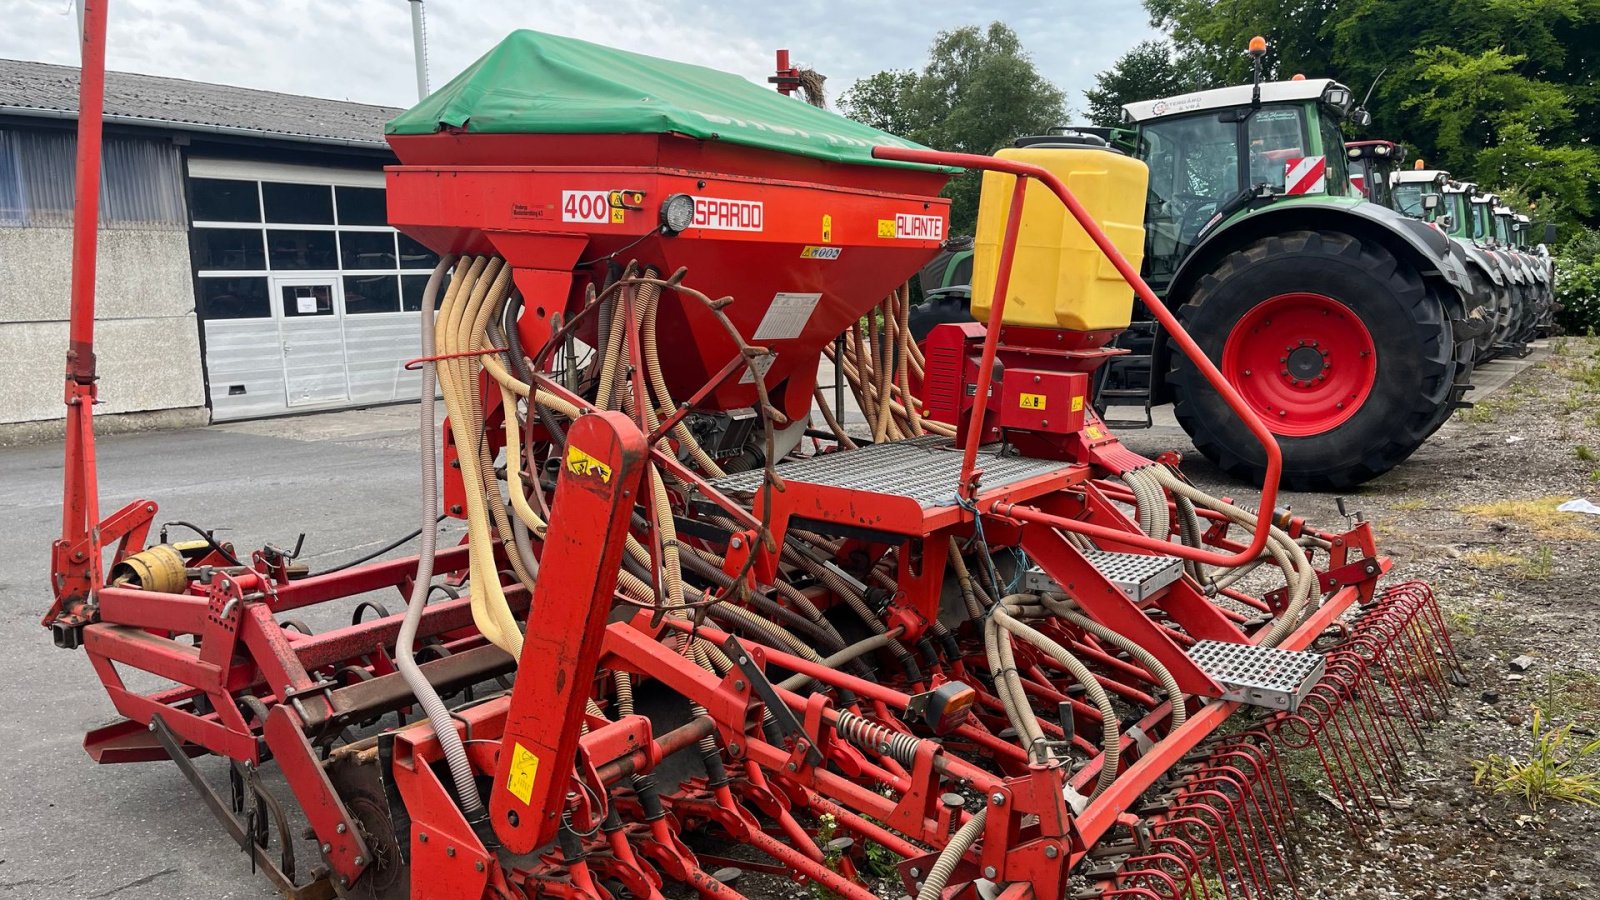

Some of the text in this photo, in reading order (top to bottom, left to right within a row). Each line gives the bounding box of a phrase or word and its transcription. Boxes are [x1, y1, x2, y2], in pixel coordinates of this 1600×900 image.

[565, 194, 607, 220] 400
[691, 200, 761, 229] SPARDO
[897, 216, 942, 237] ALIANTE
